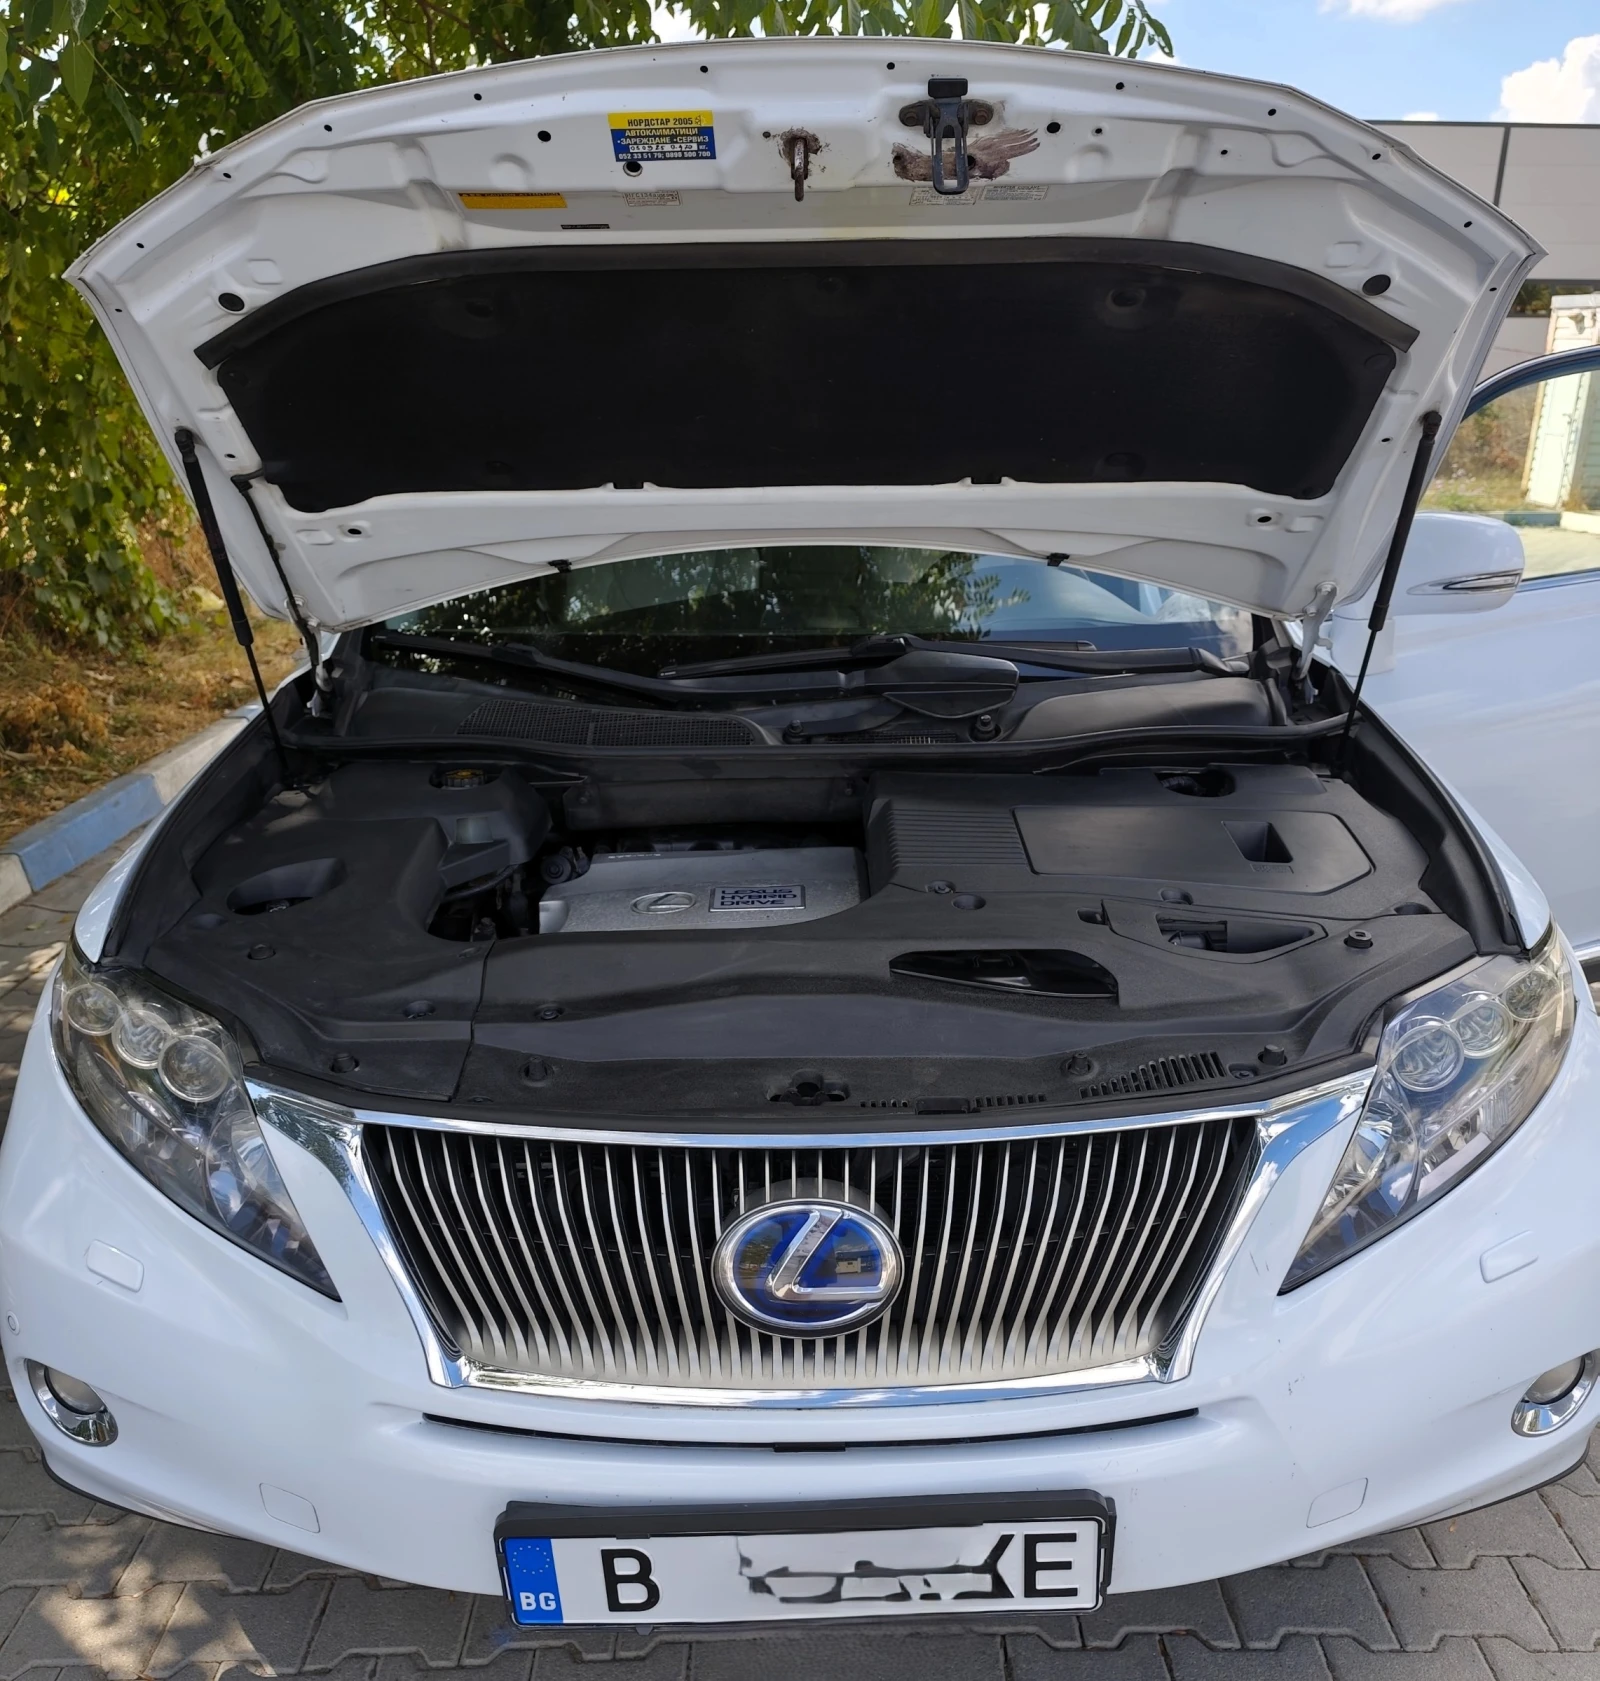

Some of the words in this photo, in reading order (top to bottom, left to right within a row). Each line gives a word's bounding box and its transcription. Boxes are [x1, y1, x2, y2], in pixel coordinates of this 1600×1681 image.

[627, 118, 671, 127] НОРДСТАР
[625, 128, 698, 137] АВТОКЛИМАТИЦИ
[600, 1548, 659, 1613] B
[520, 1593, 557, 1611] BG
